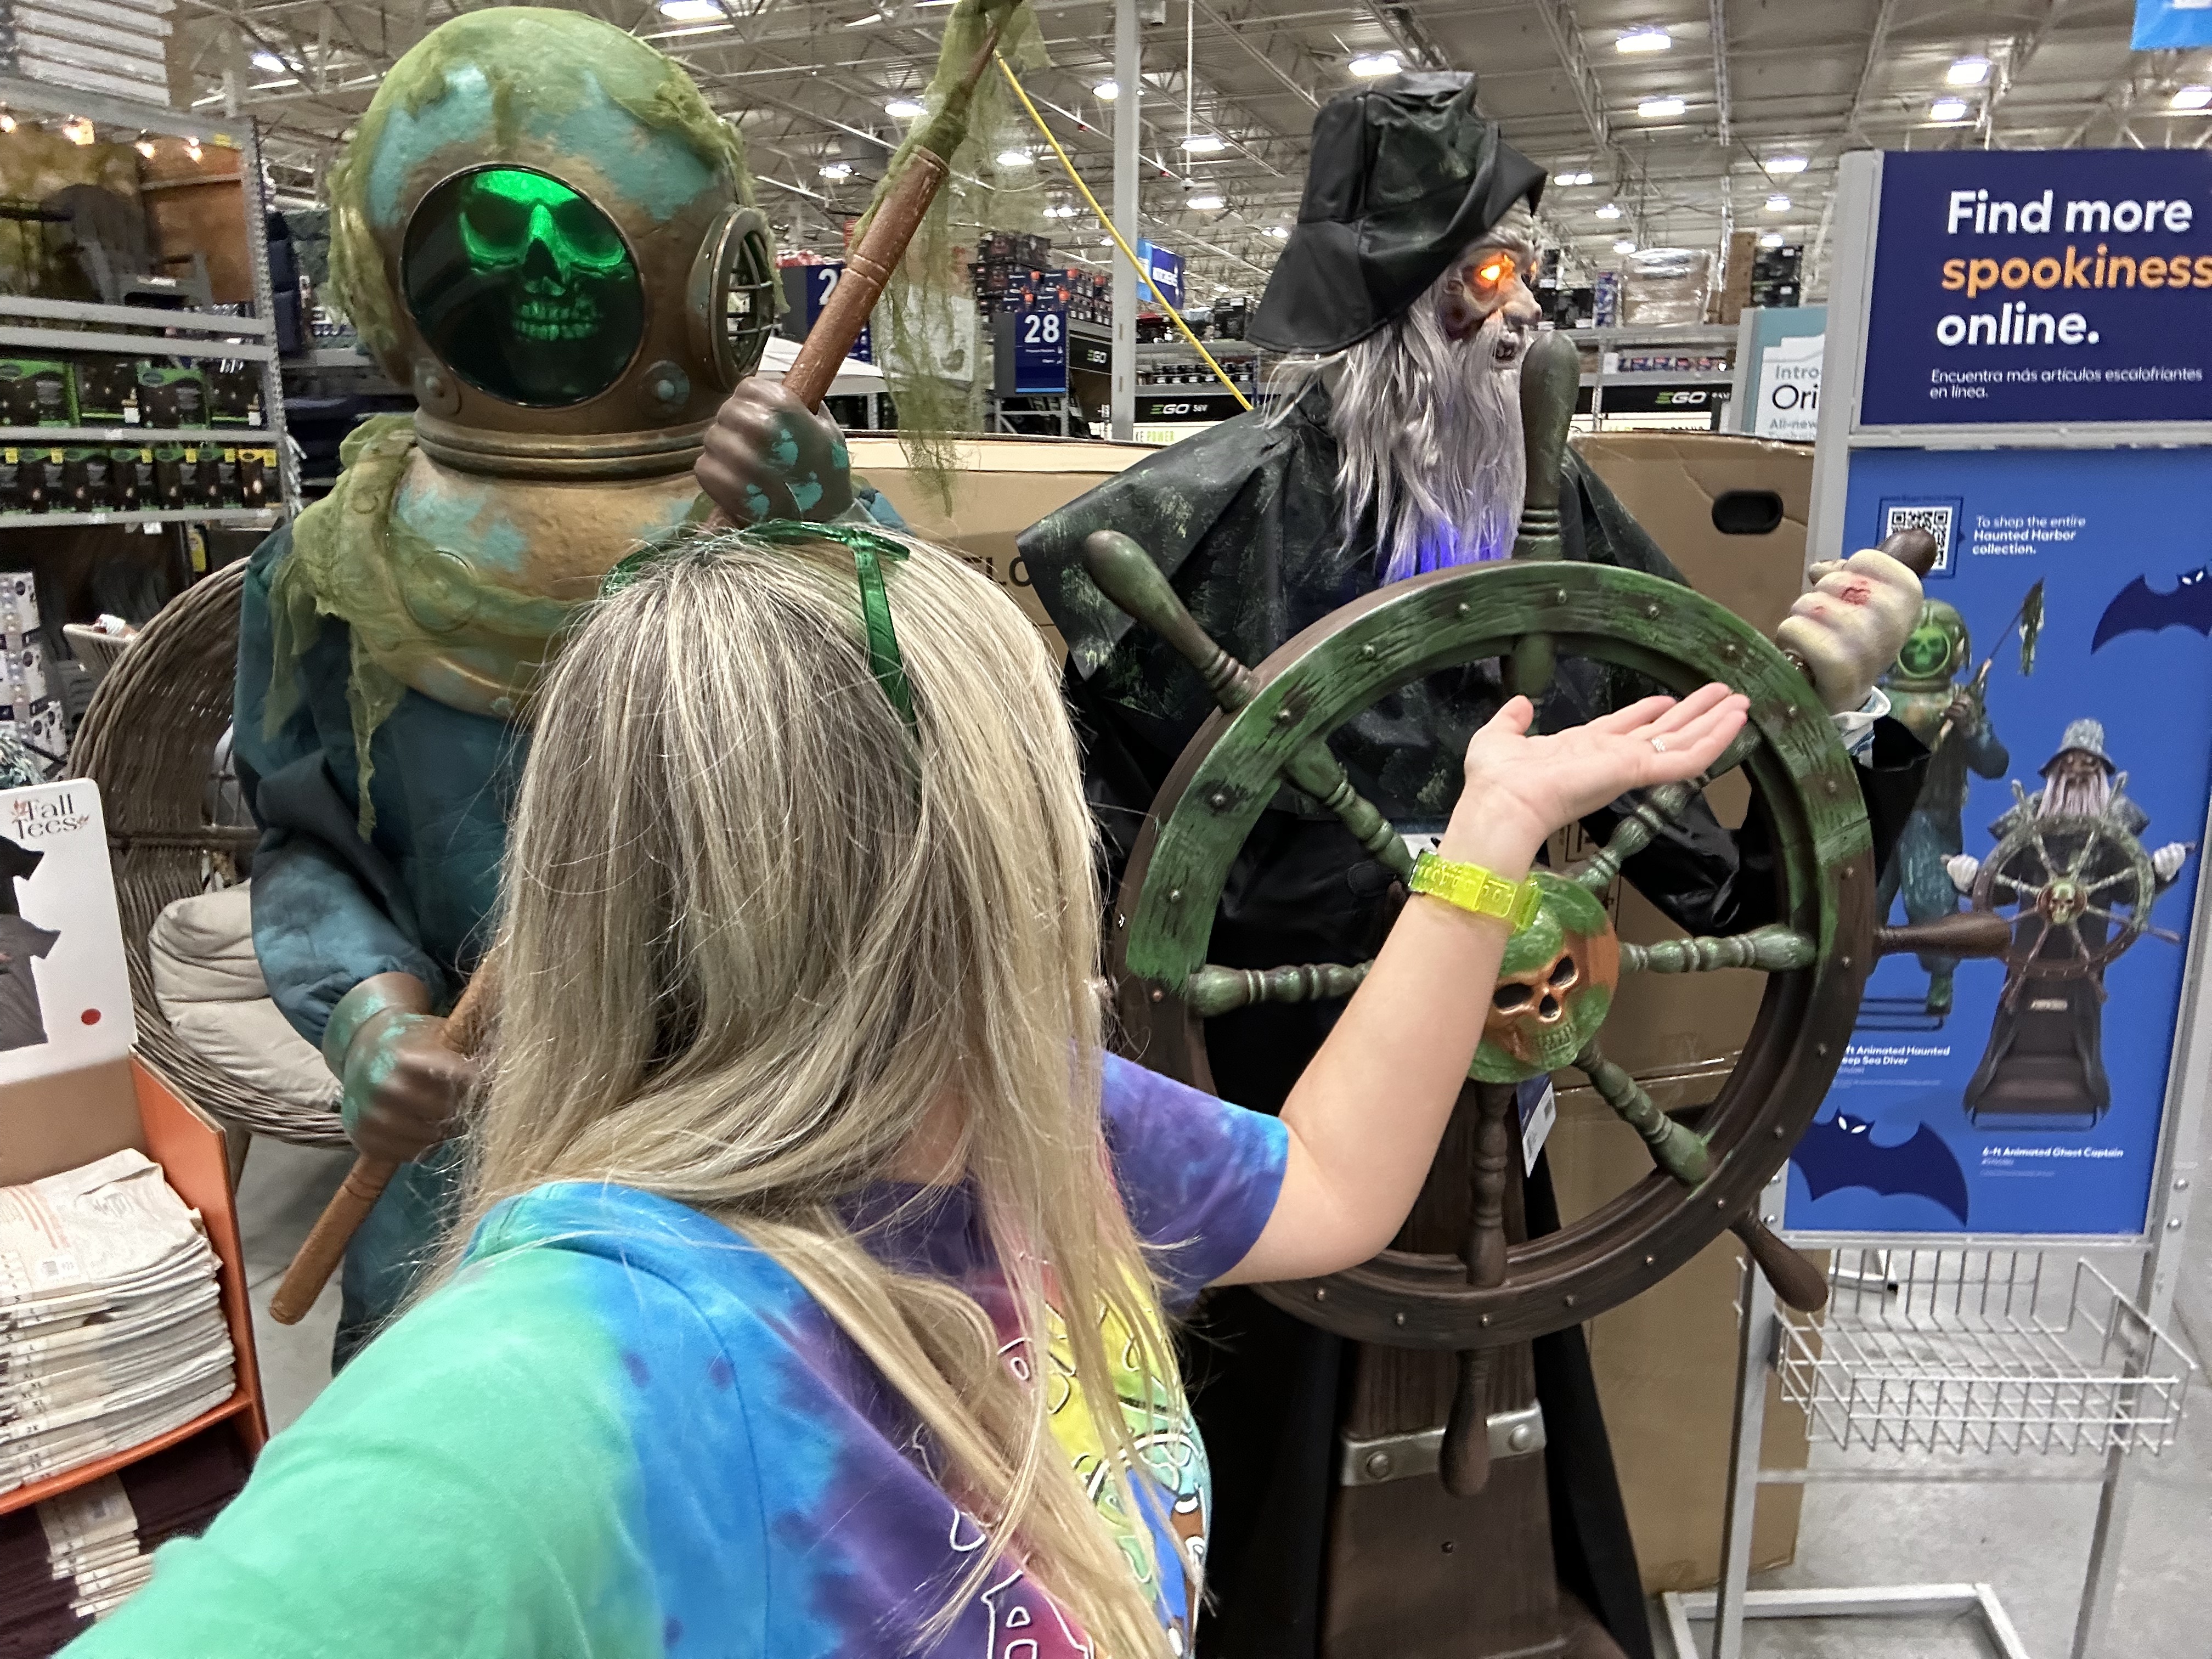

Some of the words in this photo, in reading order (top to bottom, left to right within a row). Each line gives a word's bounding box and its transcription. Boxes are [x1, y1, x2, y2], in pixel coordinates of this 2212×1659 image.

[1948, 189, 2053, 234] Find
[2065, 199, 2193, 233] more
[1942, 244, 2212, 298] spookiness
[818, 268, 838, 306] 2
[1024, 314, 1060, 343] 28
[1937, 301, 2100, 346] online.
[1775, 365, 1819, 379] Intro
[1931, 368, 2003, 383] Encuentra
[2006, 367, 2038, 383] más
[2041, 366, 2102, 382] artículos
[2104, 366, 2203, 382] escalofriantes
[1655, 391, 1707, 404] EGO
[1772, 384, 1818, 409] Ori
[1929, 387, 1948, 399] en
[1951, 385, 1989, 399] línea.
[1150, 404, 1190, 414] EGO
[1976, 515, 1991, 528] To
[1993, 515, 2024, 529] shop
[2028, 514, 2047, 528] the
[2050, 514, 2086, 528] entire
[1974, 528, 2029, 541] Haunted
[2032, 528, 2076, 541] Harbor
[1972, 541, 2036, 555] collection.
[24, 793, 74, 820] Fall
[1845, 1045, 1854, 1055] ft
[1856, 1045, 1905, 1056] Animated
[1906, 1045, 1951, 1056] Haunted
[1841, 1056, 1861, 1066] eep
[1862, 1056, 1881, 1065] Sea
[1883, 1056, 1909, 1065] Diver
[2002, 1146, 2052, 1158] Animated
